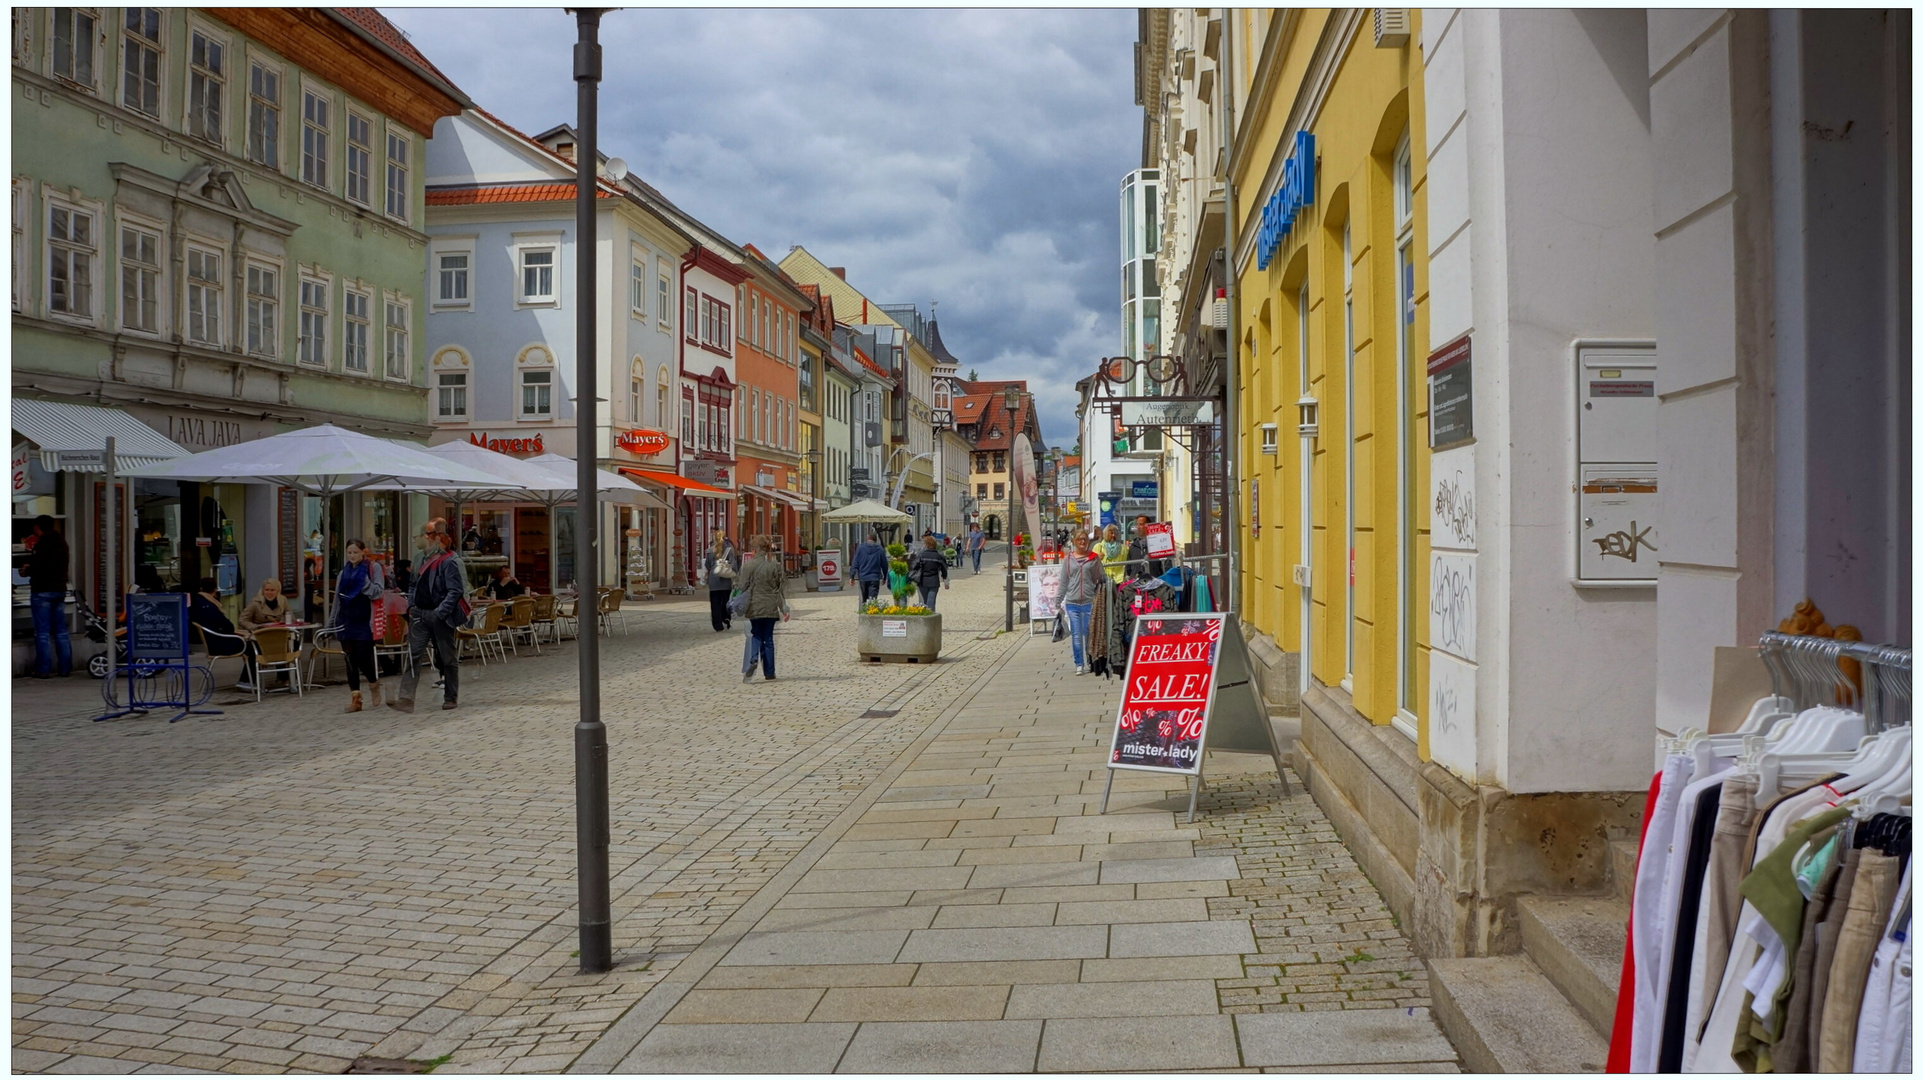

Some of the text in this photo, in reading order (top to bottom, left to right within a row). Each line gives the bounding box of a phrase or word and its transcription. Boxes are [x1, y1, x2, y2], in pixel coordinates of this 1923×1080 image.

[1146, 403, 1189, 411] Augenoptik
[1136, 414, 1199, 424] Autenrieth
[168, 415, 241, 447] LAVA JAVA
[687, 462, 710, 470] geyer
[1137, 642, 1209, 663] FREAKY
[1130, 673, 1208, 701] SALE!
